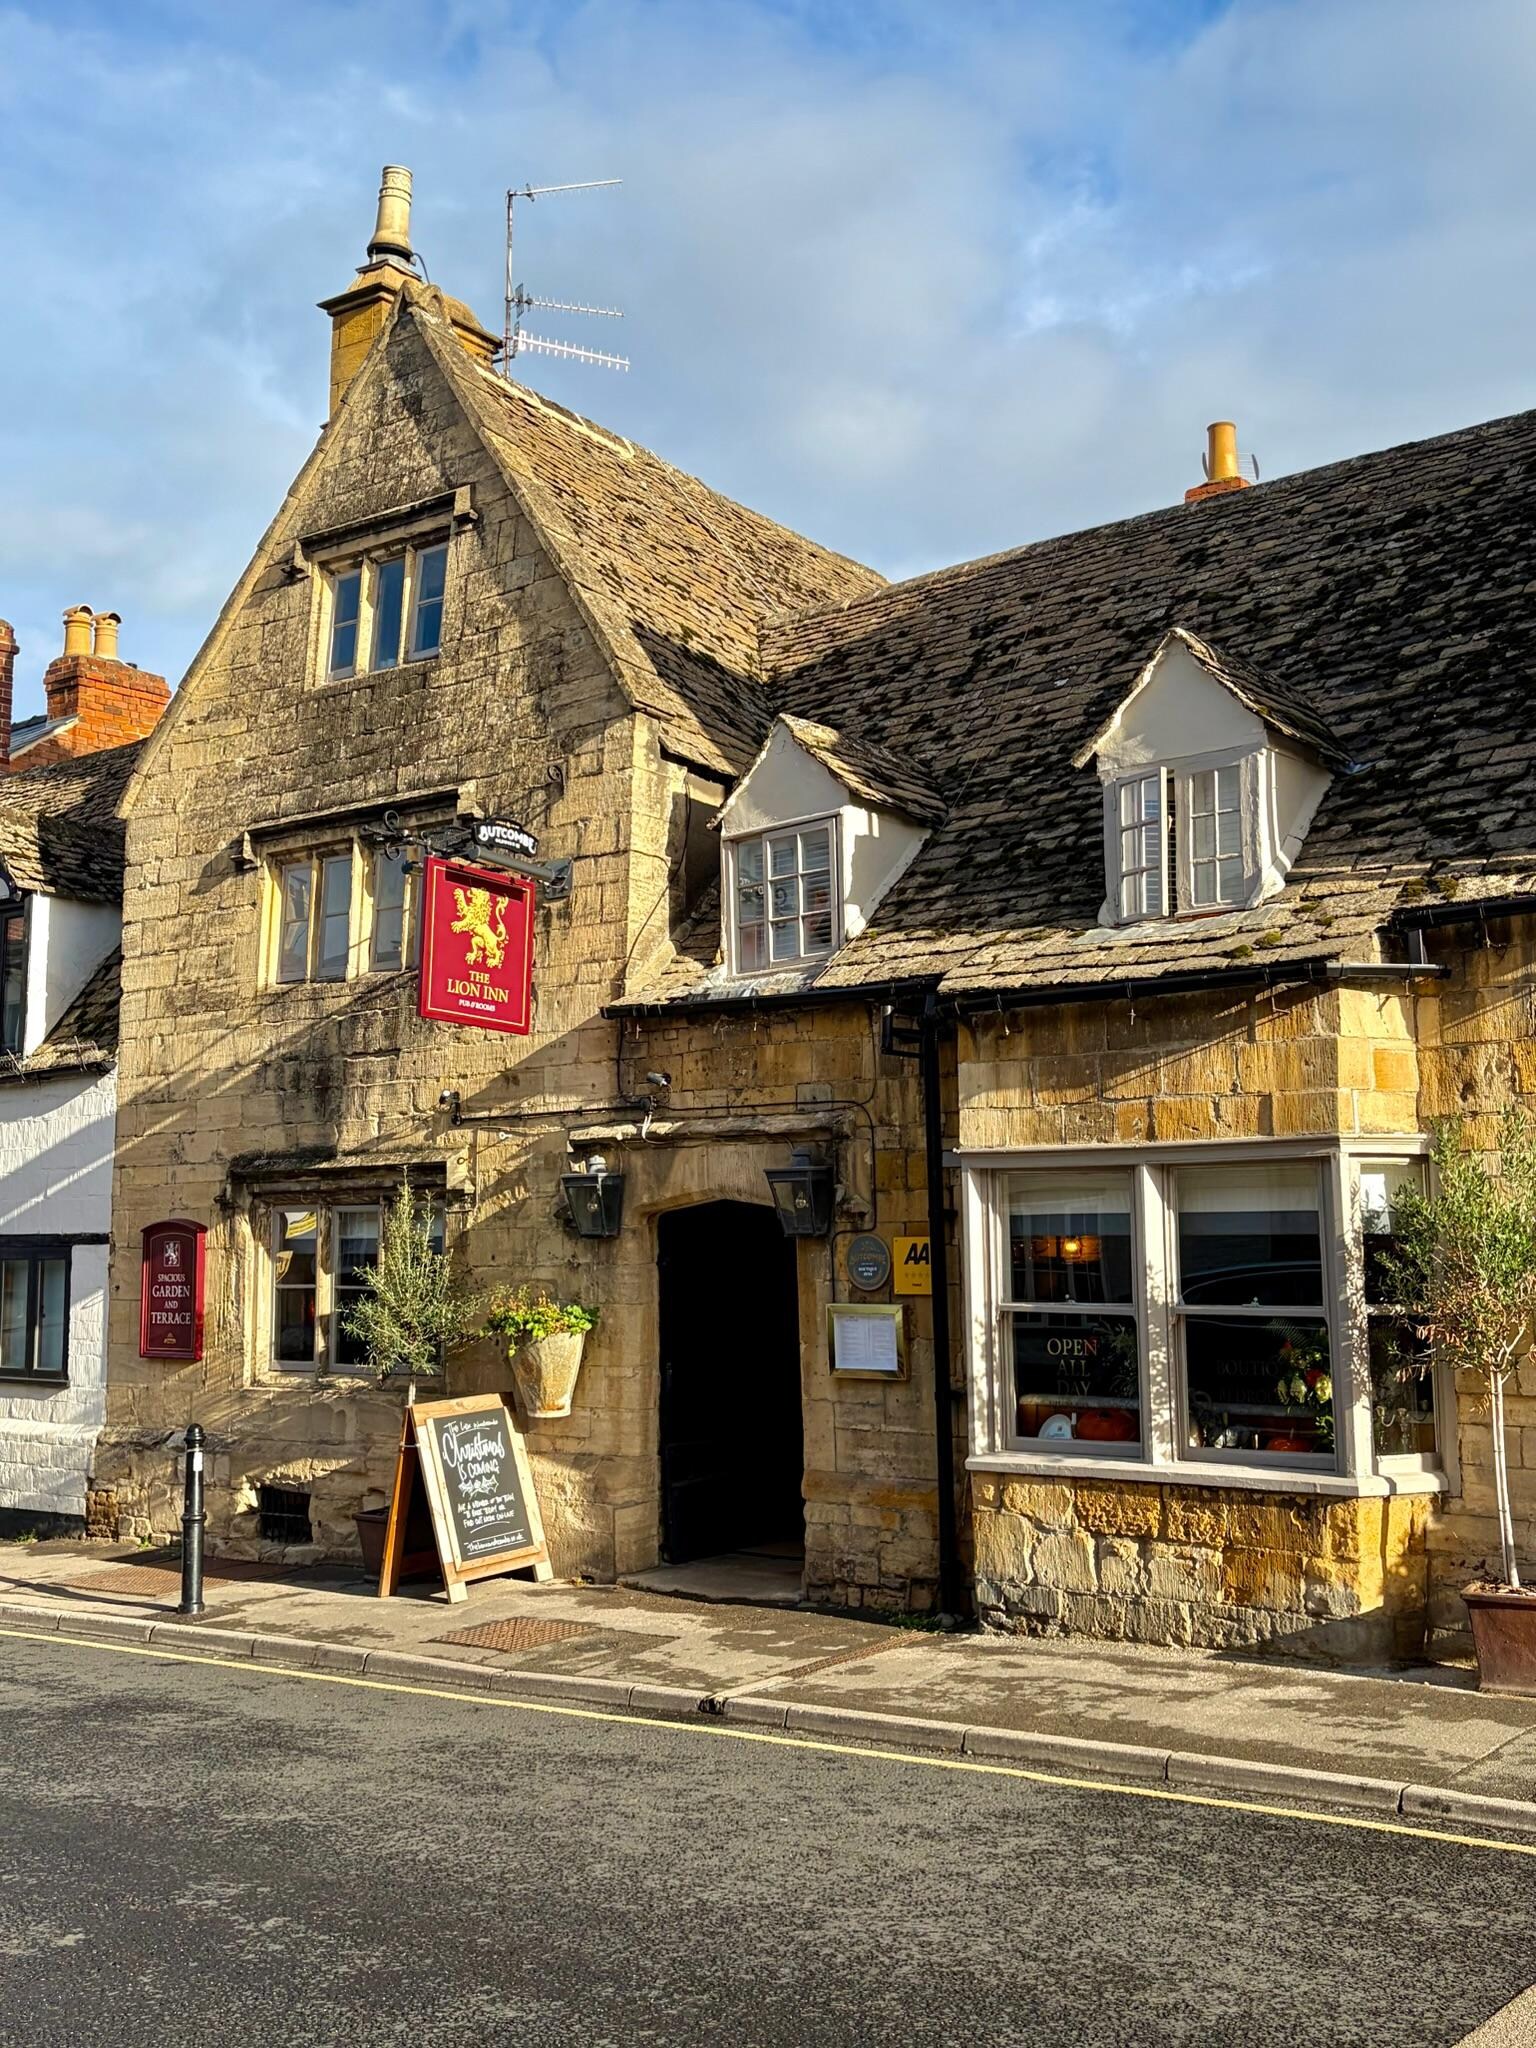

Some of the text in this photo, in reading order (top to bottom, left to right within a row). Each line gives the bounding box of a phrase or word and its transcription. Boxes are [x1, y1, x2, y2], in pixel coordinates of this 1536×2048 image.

[478, 825, 538, 855] BUTCOMBE
[469, 970, 490, 984] THE
[447, 978, 509, 1003] LION INN
[904, 1243, 930, 1265] AA
[158, 1273, 186, 1282] SPACIOUS
[152, 1285, 191, 1298] GARDEN
[164, 1300, 179, 1309] AND
[151, 1312, 191, 1324] TERRACE
[1047, 1338, 1098, 1356] OPEN
[1056, 1359, 1092, 1376] ALL
[1056, 1379, 1092, 1396] DAY
[442, 1431, 505, 1468] Christmas
[467, 1459, 500, 1479] COMING
